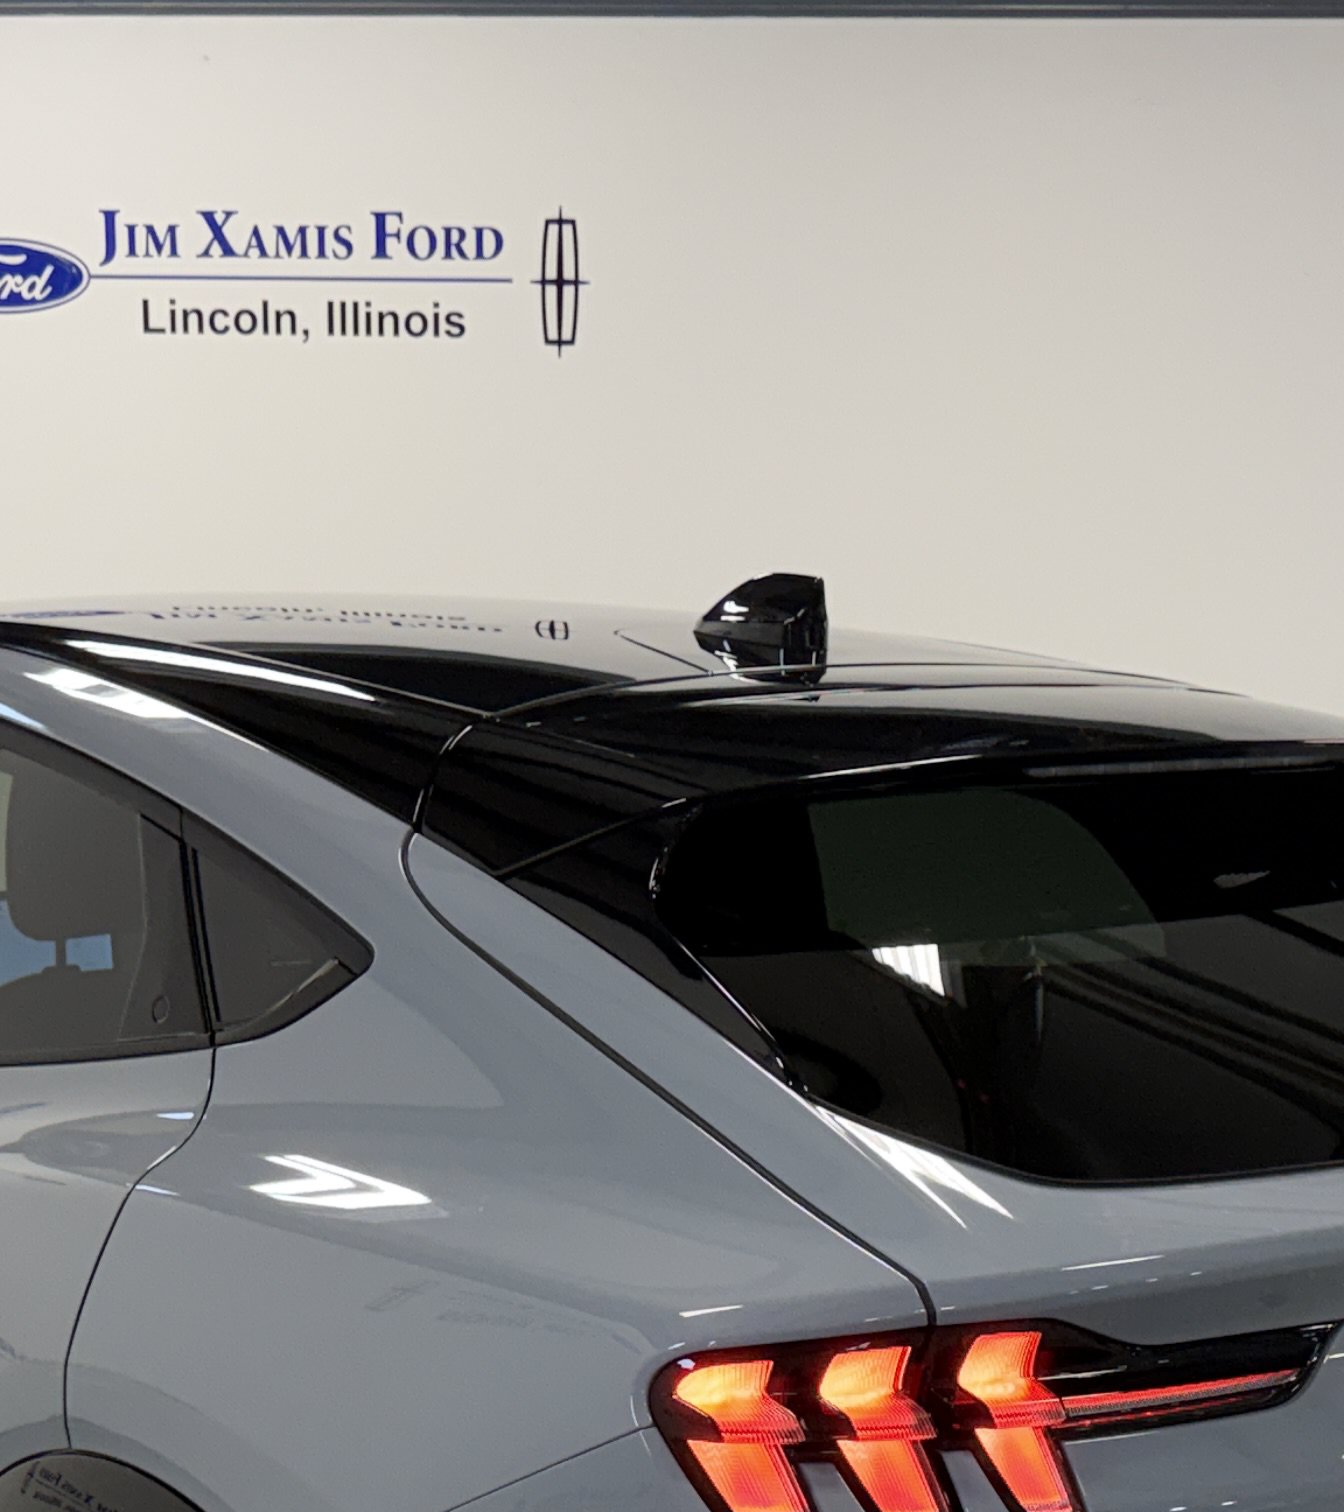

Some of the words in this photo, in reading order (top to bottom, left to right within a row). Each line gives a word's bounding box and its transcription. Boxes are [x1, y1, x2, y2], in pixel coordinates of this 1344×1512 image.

[99, 209, 180, 267] JIM
[196, 210, 353, 260] XAMIS
[371, 211, 504, 261] FORD
[142, 298, 311, 344] Lincoln,
[326, 300, 466, 339] Illinois
